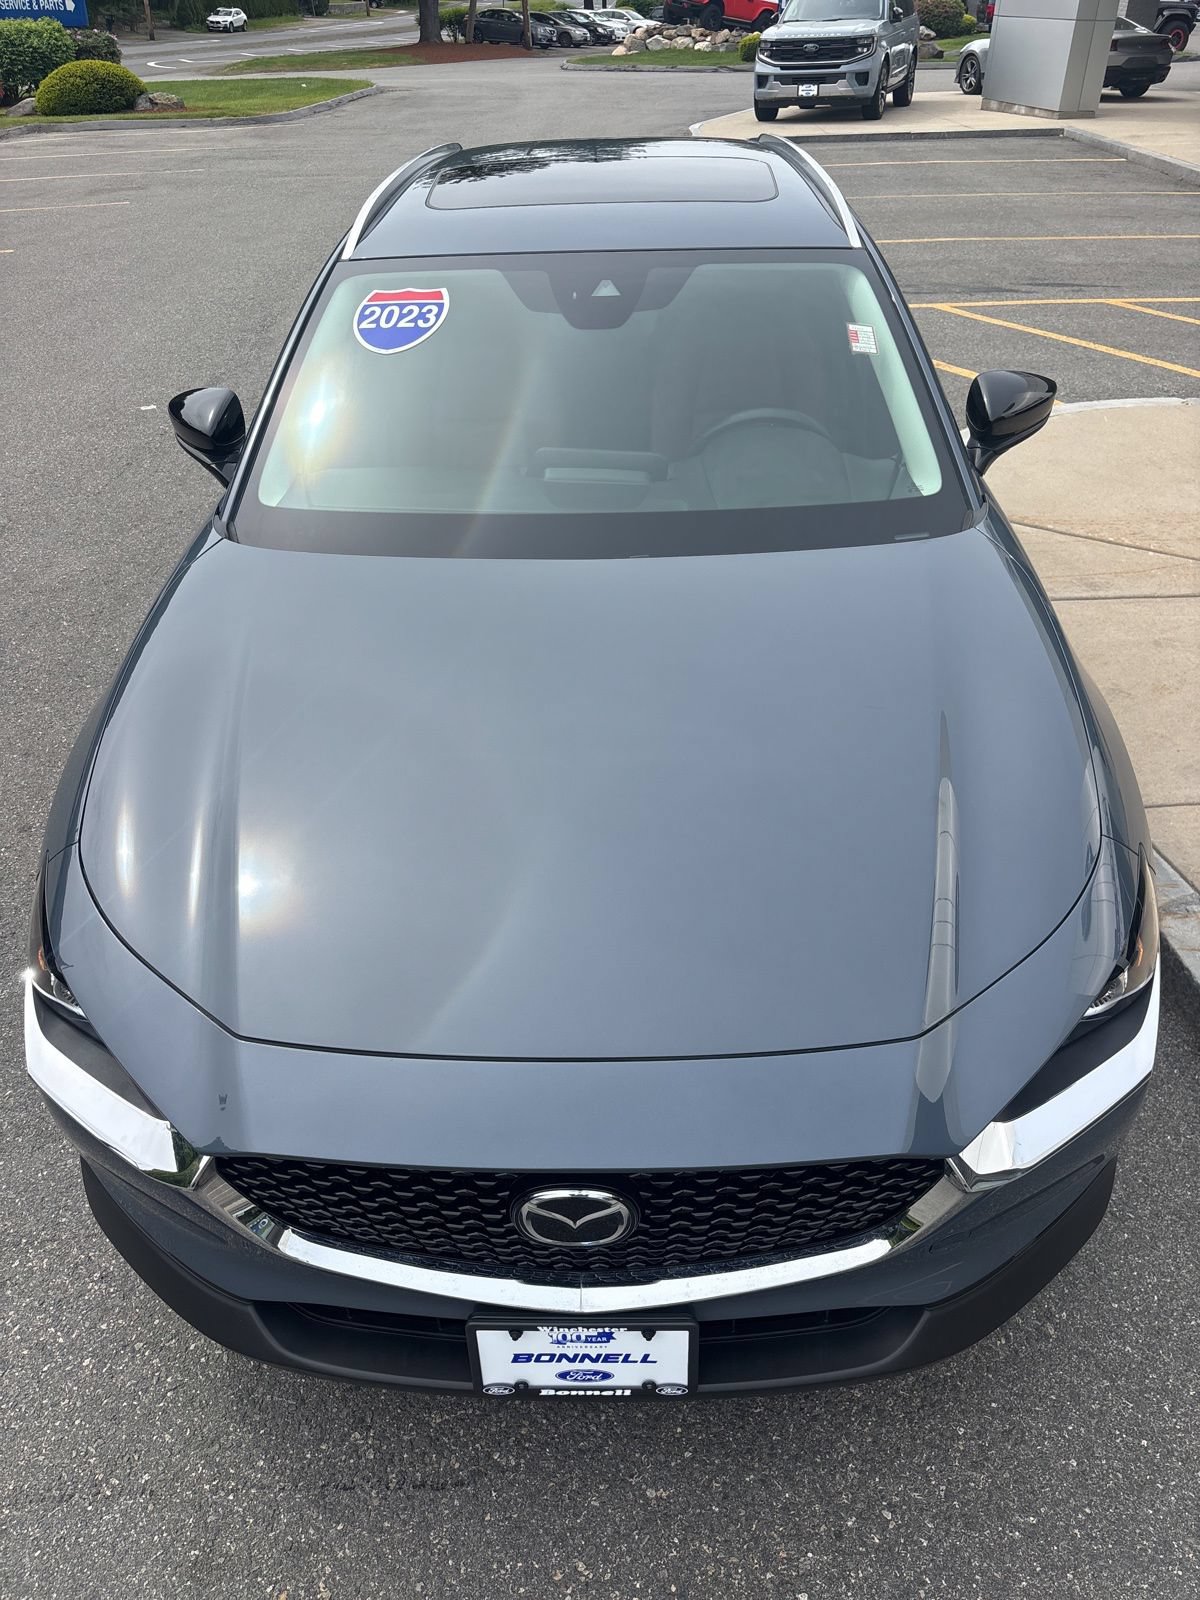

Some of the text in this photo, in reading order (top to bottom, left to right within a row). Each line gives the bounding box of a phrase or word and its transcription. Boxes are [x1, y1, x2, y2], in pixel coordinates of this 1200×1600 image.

[0, 0, 65, 11] SERVICE & PARTS
[359, 304, 438, 329] 2023
[511, 1353, 658, 1364] BONNELL
[565, 1371, 604, 1381] Ford
